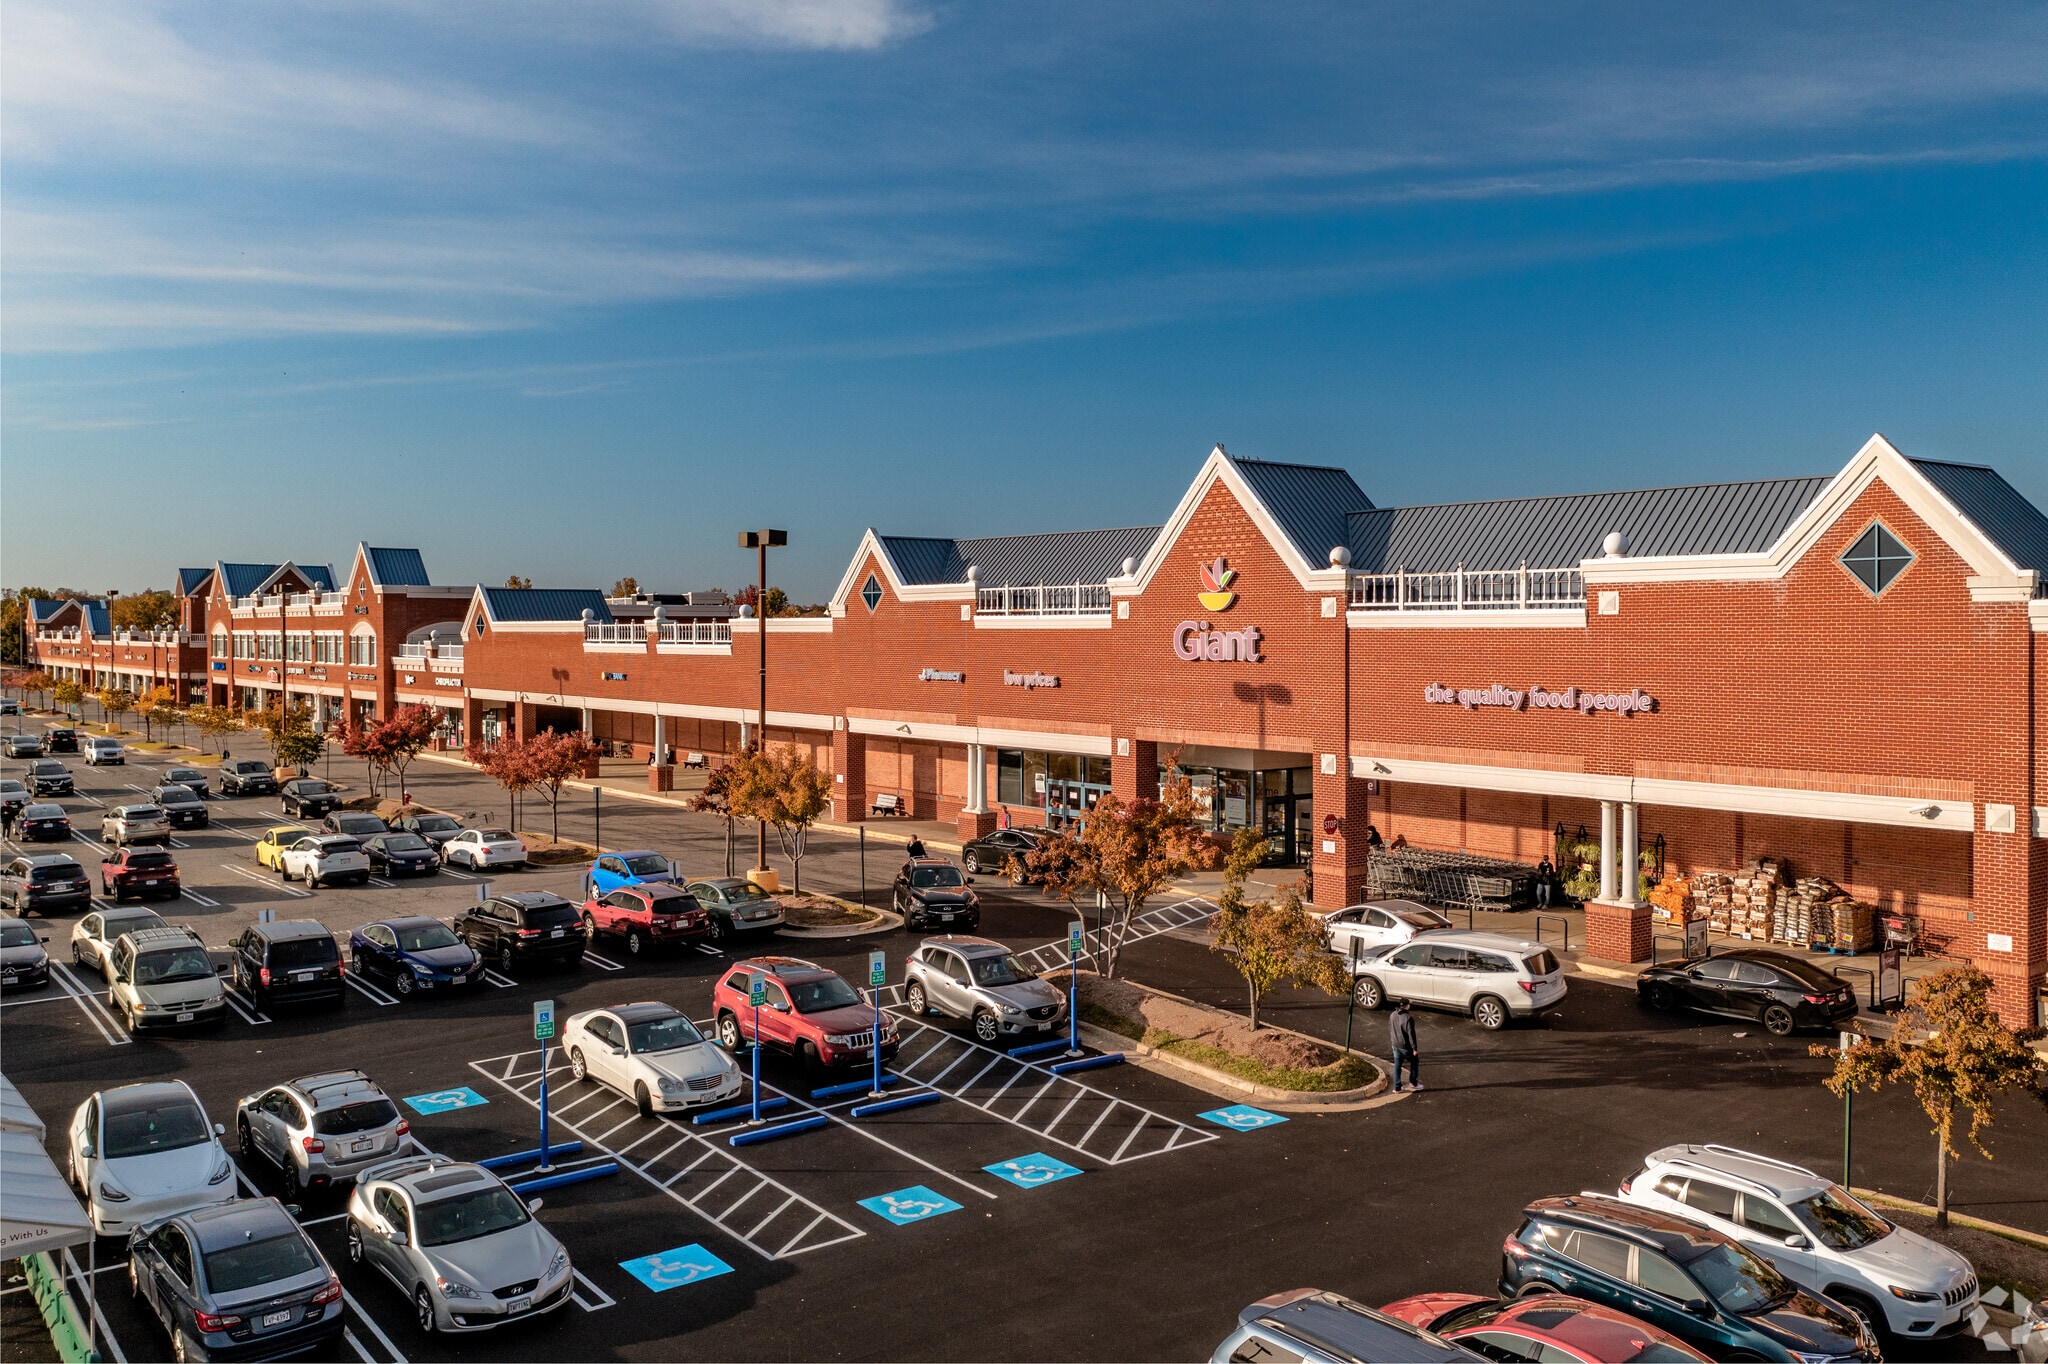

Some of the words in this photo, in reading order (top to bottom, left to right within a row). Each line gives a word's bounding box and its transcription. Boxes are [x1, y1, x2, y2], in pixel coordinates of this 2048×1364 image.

[1173, 620, 1259, 662] Giant
[925, 668, 963, 683] Pharmacy
[1004, 669, 1023, 685] low
[1024, 671, 1057, 690] prices
[1424, 682, 1454, 703] the
[1458, 685, 1521, 711] quality
[1529, 686, 1575, 708] food
[1580, 689, 1651, 716] people
[1324, 821, 1338, 830] STOP
[9, 1231, 33, 1241] With
[36, 1228, 48, 1236] Us
